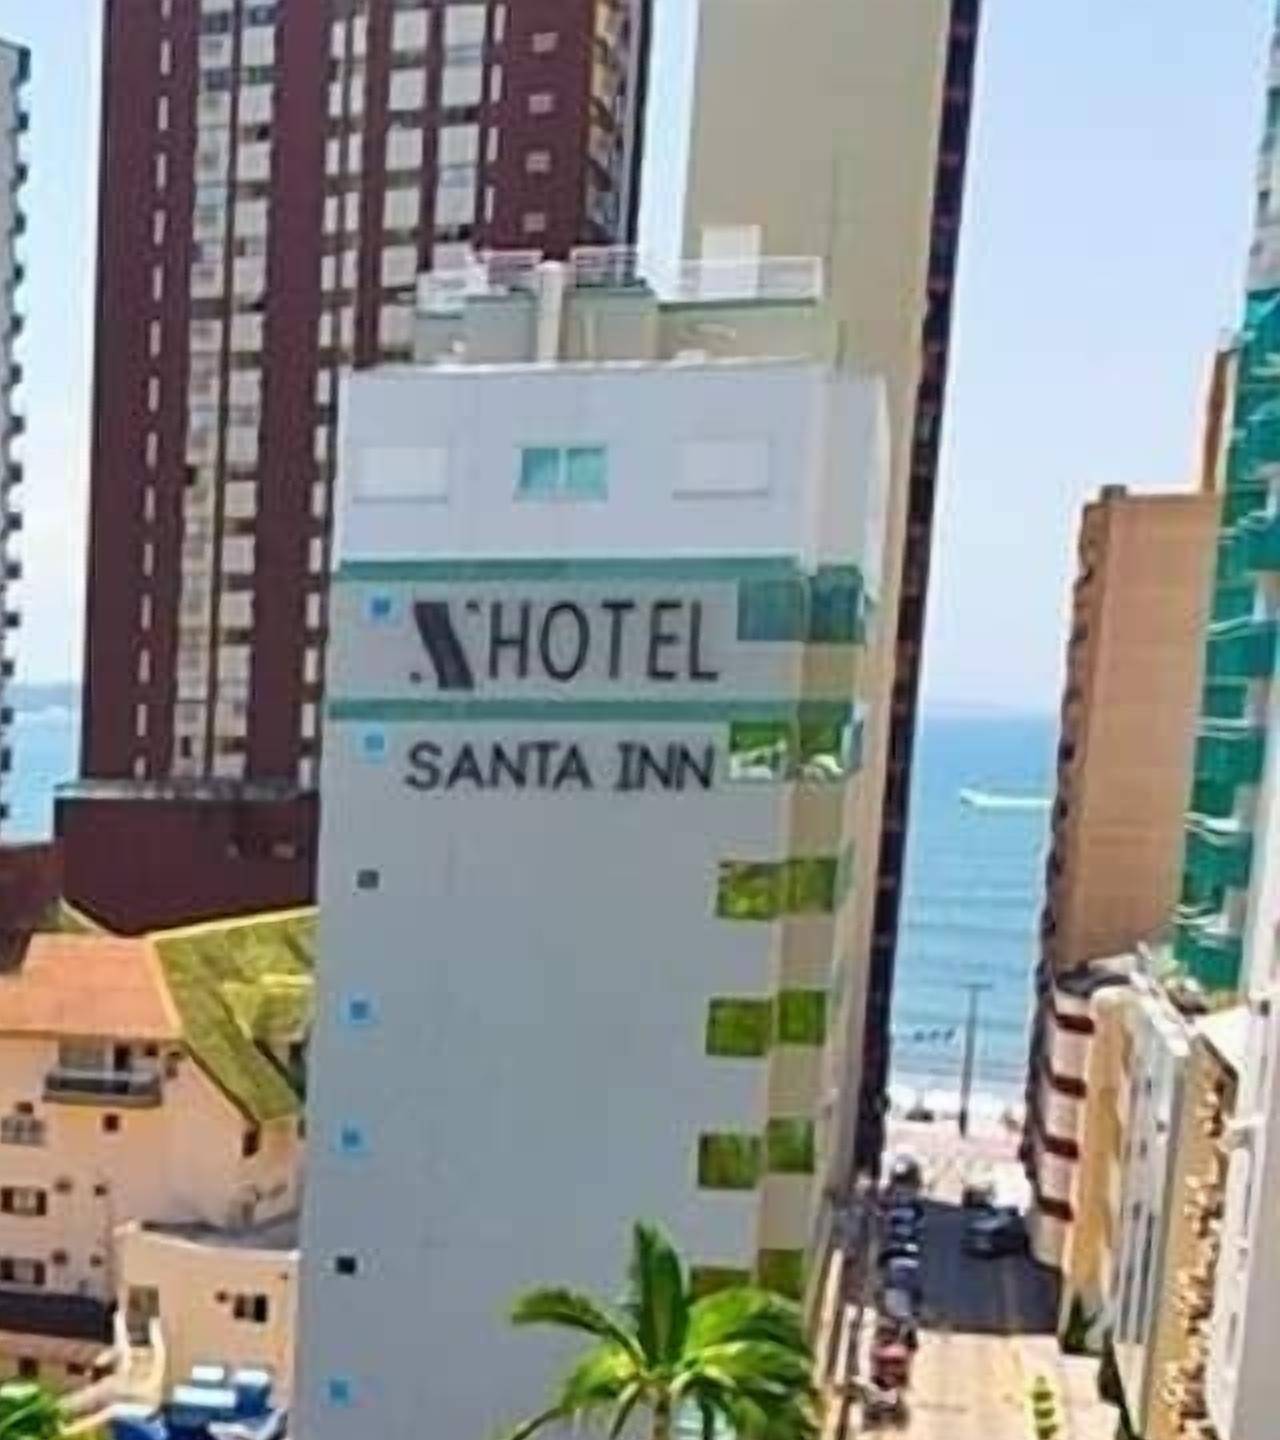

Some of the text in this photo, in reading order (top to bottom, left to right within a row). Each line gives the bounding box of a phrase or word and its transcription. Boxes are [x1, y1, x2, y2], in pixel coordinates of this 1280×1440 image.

[489, 600, 720, 682] HOTEL
[404, 740, 716, 791] SANTA INN
